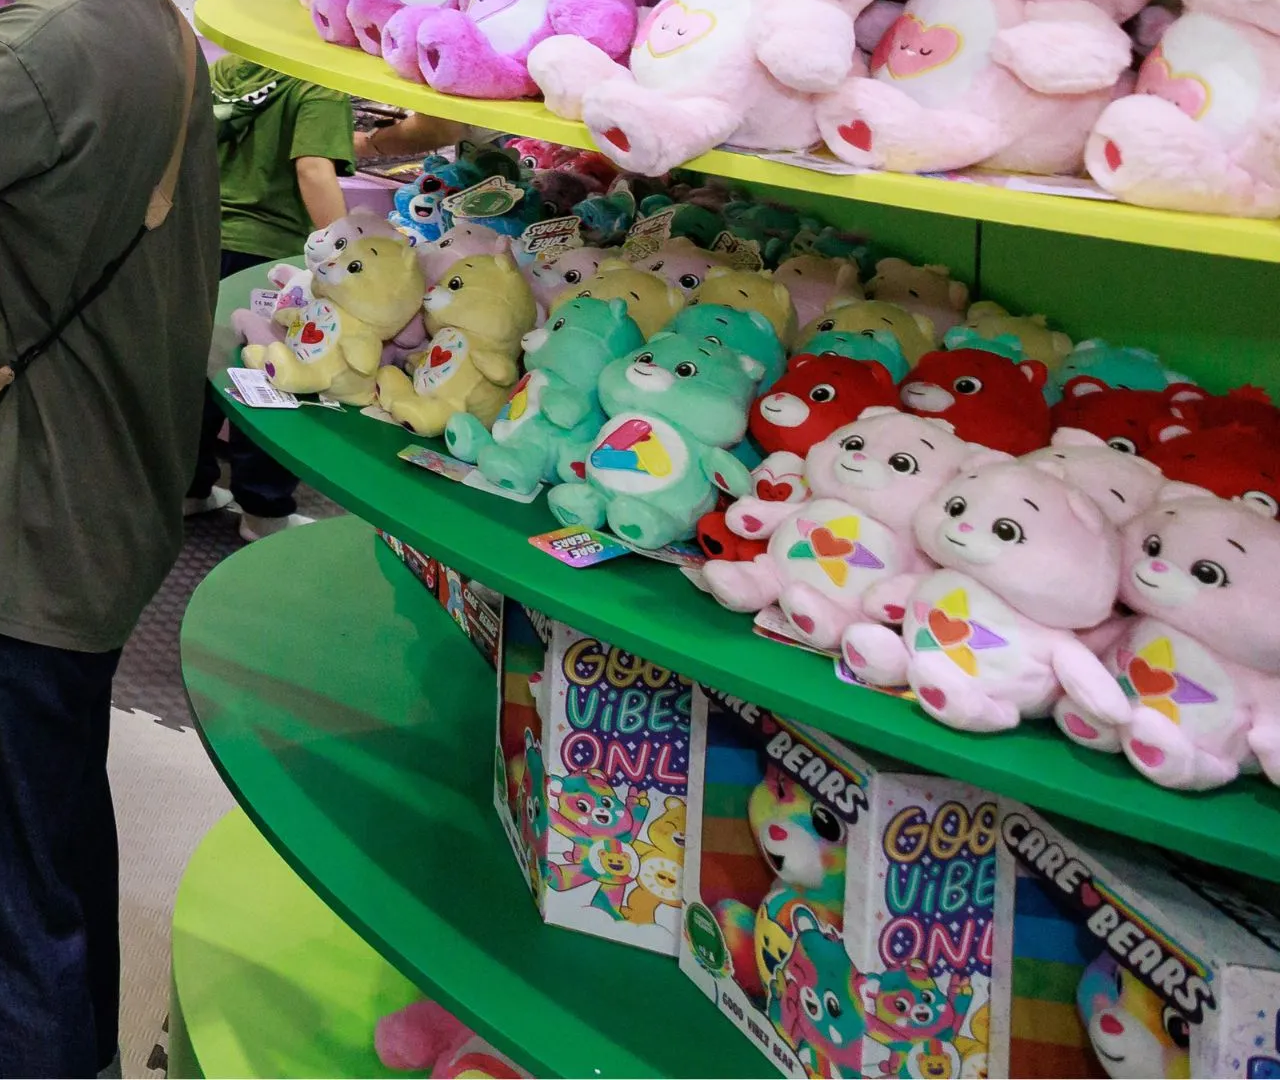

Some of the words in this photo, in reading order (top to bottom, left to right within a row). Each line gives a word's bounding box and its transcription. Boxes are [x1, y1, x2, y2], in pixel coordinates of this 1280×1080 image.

[551, 532, 591, 551] BEARS
[569, 542, 605, 559] CARE
[765, 730, 870, 815] BEARS
[1000, 812, 1094, 896] CARE
[1086, 901, 1216, 1024] BEARS
